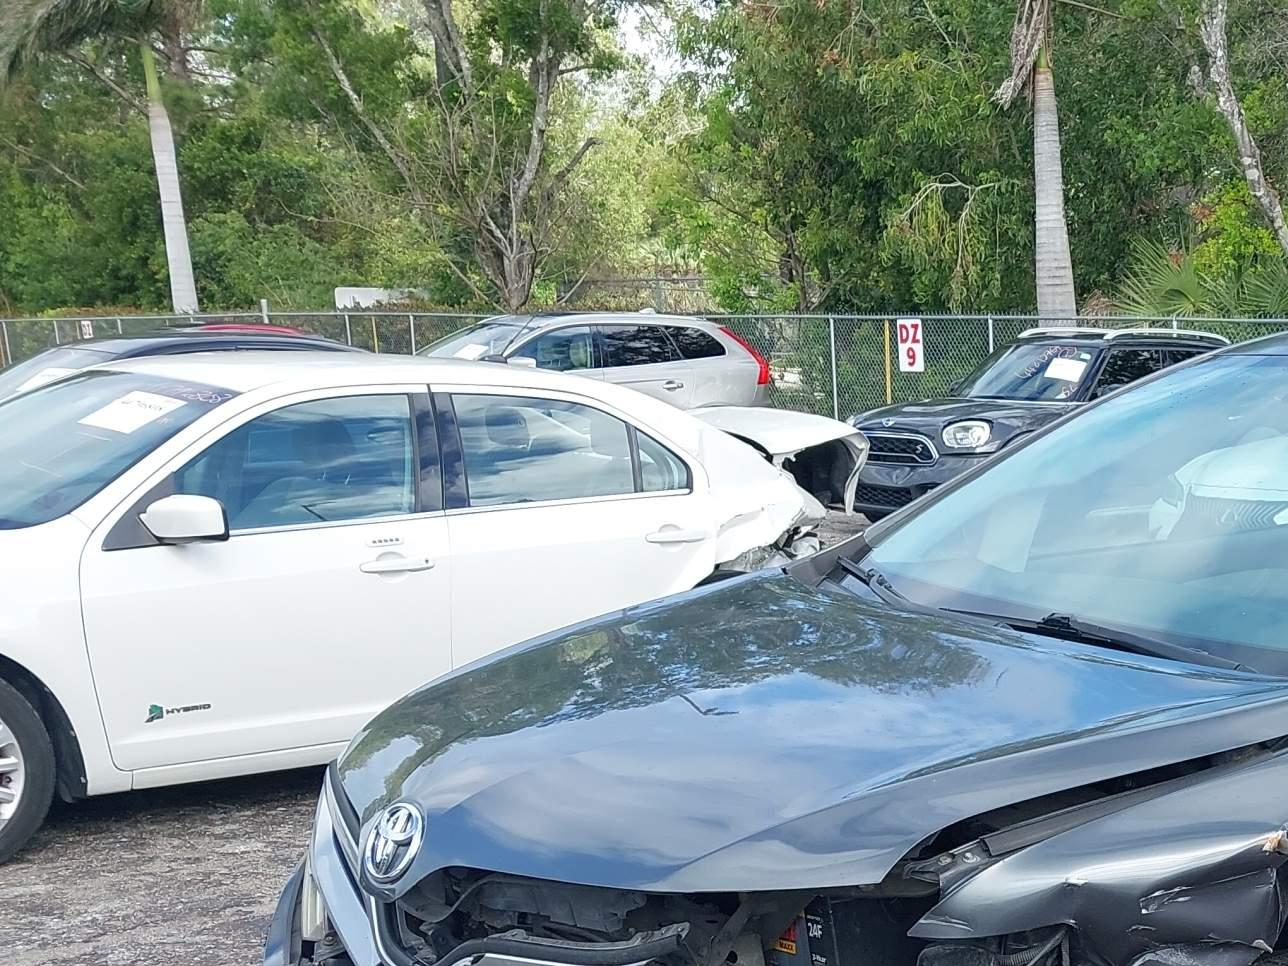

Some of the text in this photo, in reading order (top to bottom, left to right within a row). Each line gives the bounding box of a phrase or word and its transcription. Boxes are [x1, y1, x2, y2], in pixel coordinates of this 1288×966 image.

[899, 323, 920, 344] DZ
[906, 346, 916, 367] 9
[165, 703, 212, 715] HYBRID
[807, 922, 823, 939] 24F
